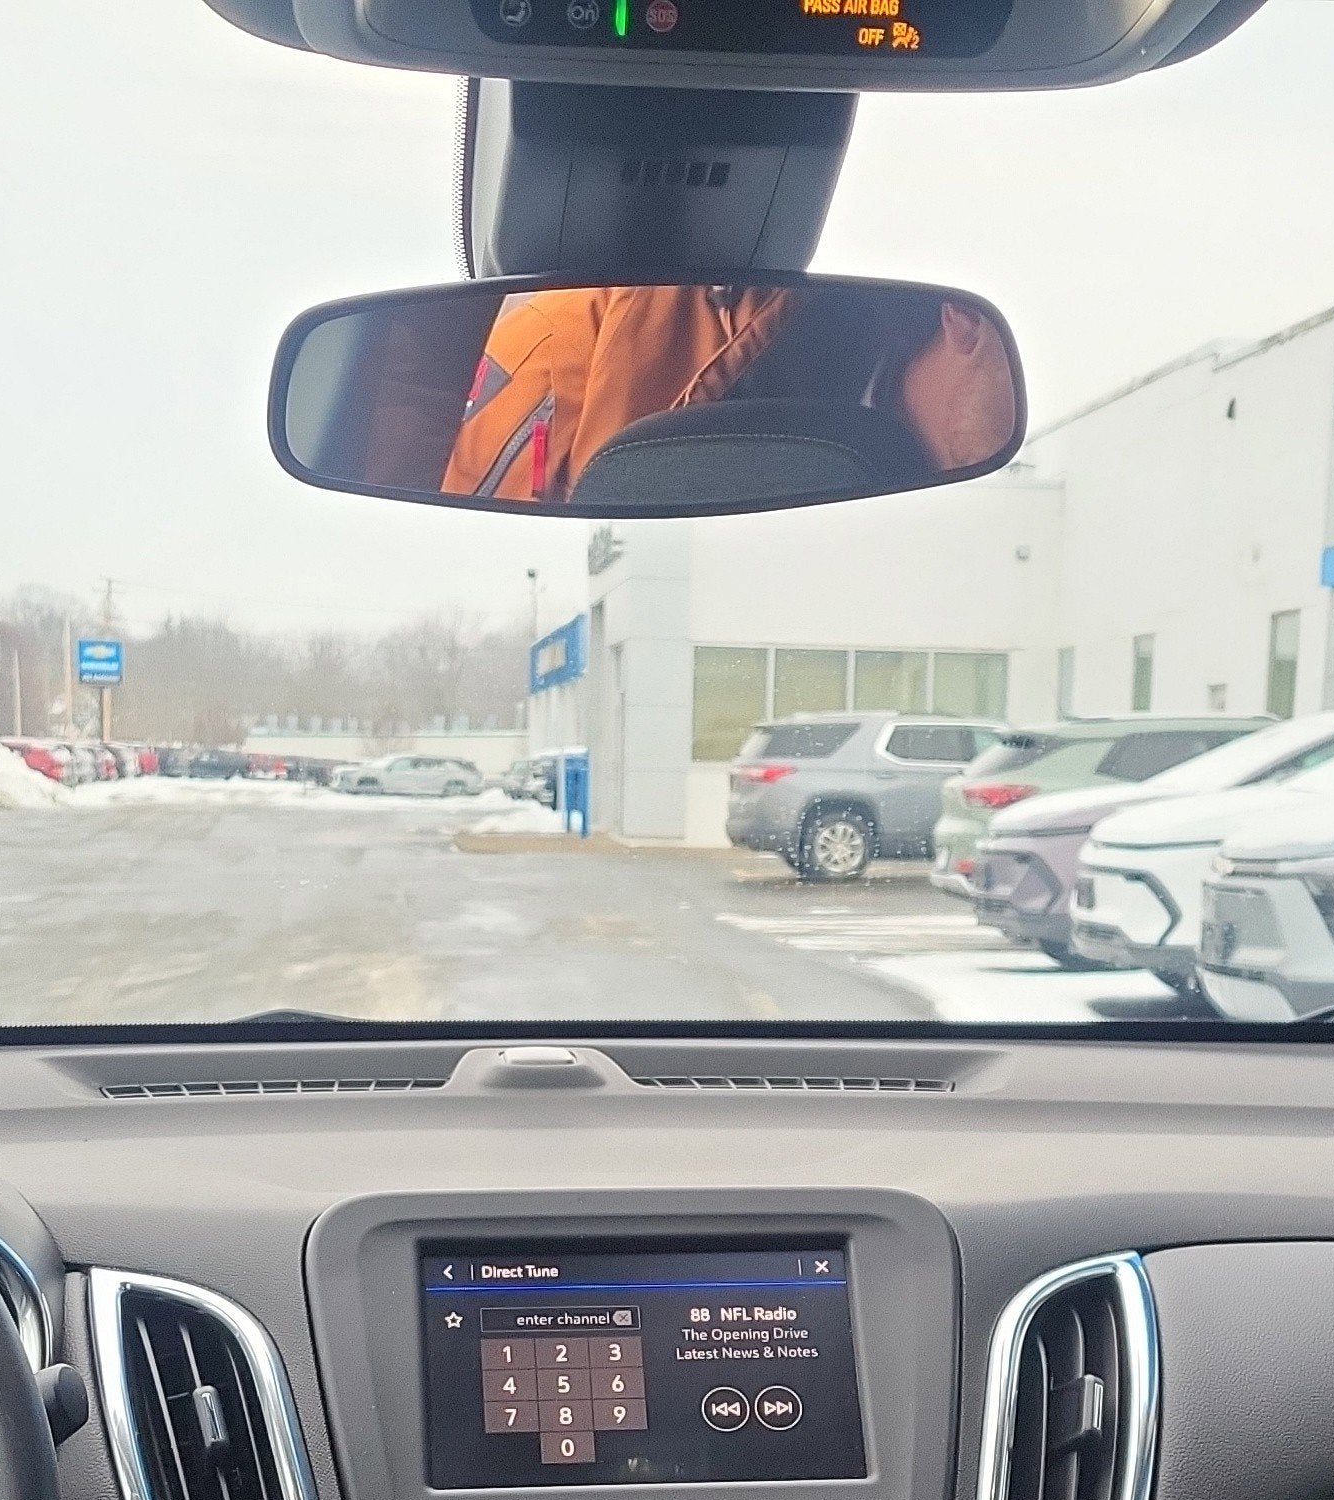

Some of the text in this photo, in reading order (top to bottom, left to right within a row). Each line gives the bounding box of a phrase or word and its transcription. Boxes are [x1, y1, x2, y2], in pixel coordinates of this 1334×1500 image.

[649, 9, 677, 23] SOS
[803, 0, 899, 16] PASS AIR BAG
[858, 27, 885, 46] OFF
[481, 1264, 559, 1278] Direct Tune
[516, 1311, 610, 1326] enter channel
[690, 1306, 797, 1322] 88 NFL Radio
[681, 1327, 809, 1343] The Opening Drive
[502, 1343, 622, 1363] 1 2 3
[676, 1345, 819, 1360] Latest News & Notes
[502, 1374, 625, 1395] 4 5 6
[504, 1406, 626, 1427] 7 8 9
[560, 1438, 575, 1457] 0
